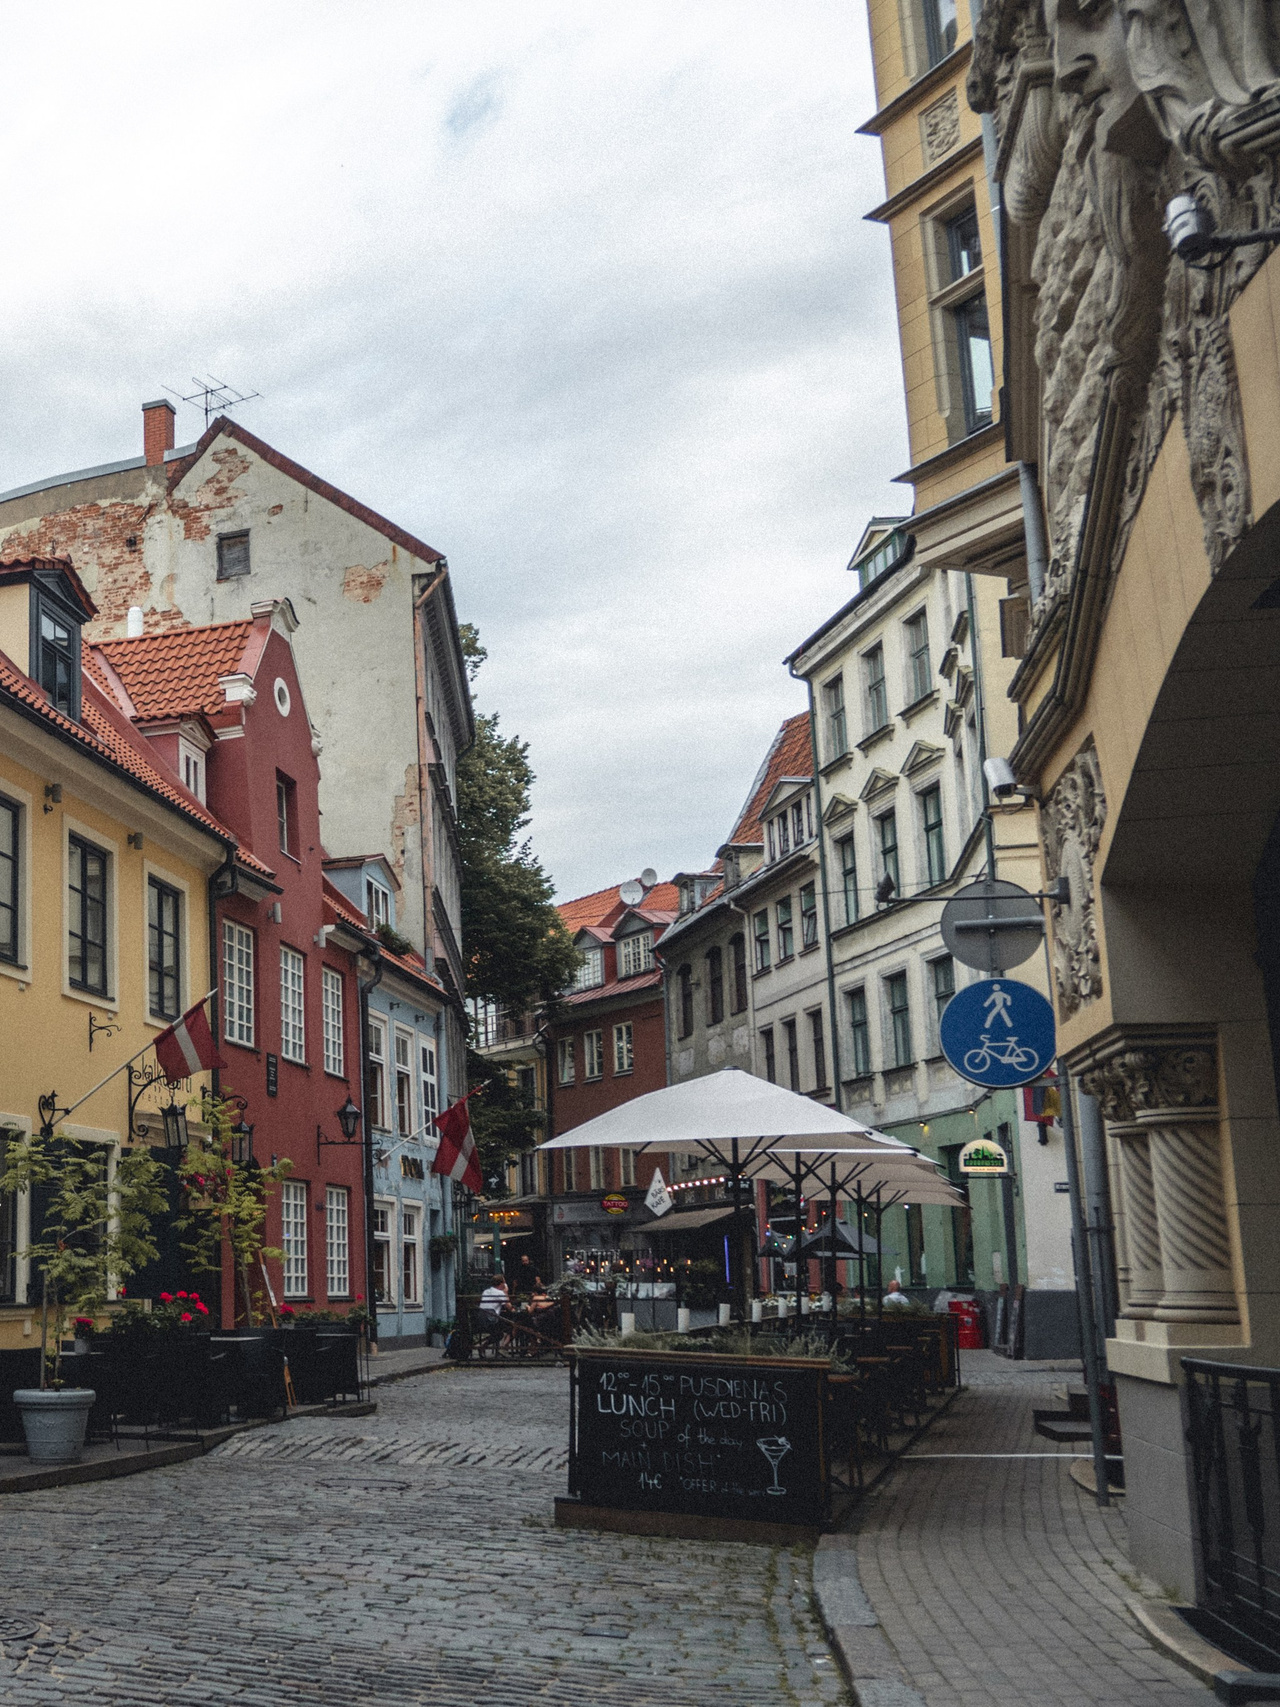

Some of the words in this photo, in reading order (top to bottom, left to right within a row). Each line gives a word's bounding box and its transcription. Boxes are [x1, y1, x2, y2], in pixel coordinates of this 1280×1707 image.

[602, 1200, 629, 1208] TATTOO
[680, 1375, 788, 1404] PUSDIENAS
[597, 1393, 676, 1420] LUNCH
[693, 1399, 787, 1426] (WED-FRI)
[620, 1419, 670, 1439] SOUP
[677, 1423, 690, 1449] of
[697, 1427, 716, 1445] the
[720, 1429, 743, 1451] day
[601, 1450, 651, 1470] MAIN
[638, 1472, 663, 1490] 14€
